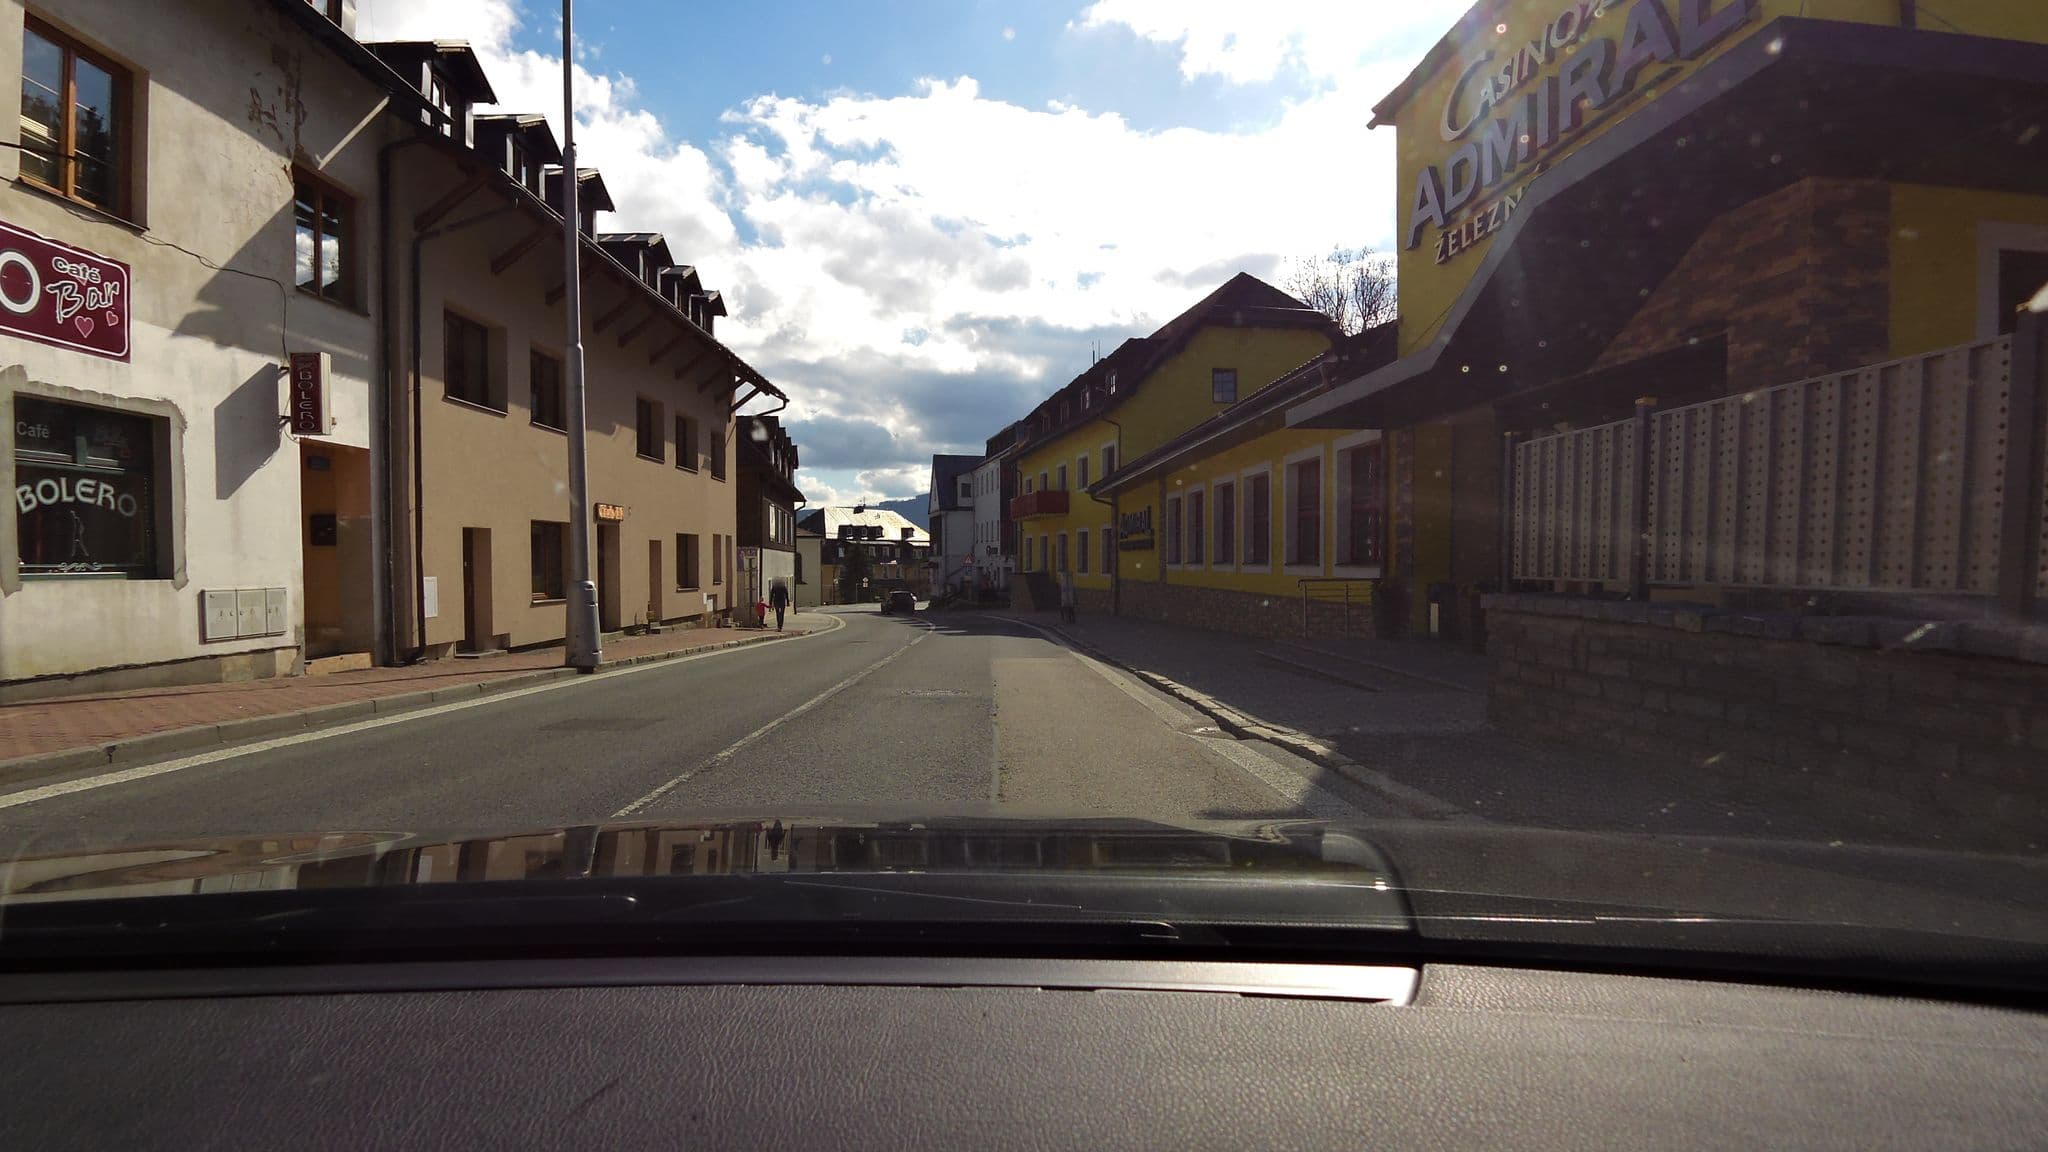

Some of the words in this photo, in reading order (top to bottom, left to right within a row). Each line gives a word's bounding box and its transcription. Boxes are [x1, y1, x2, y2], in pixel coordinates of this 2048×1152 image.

[1405, 0, 1756, 251] ADMIRAL
[1434, 185, 1525, 265] ŽELEZN
[51, 256, 101, 283] Café
[46, 280, 120, 325] Bar
[16, 421, 51, 439] Café
[15, 477, 138, 517] BOLERO
